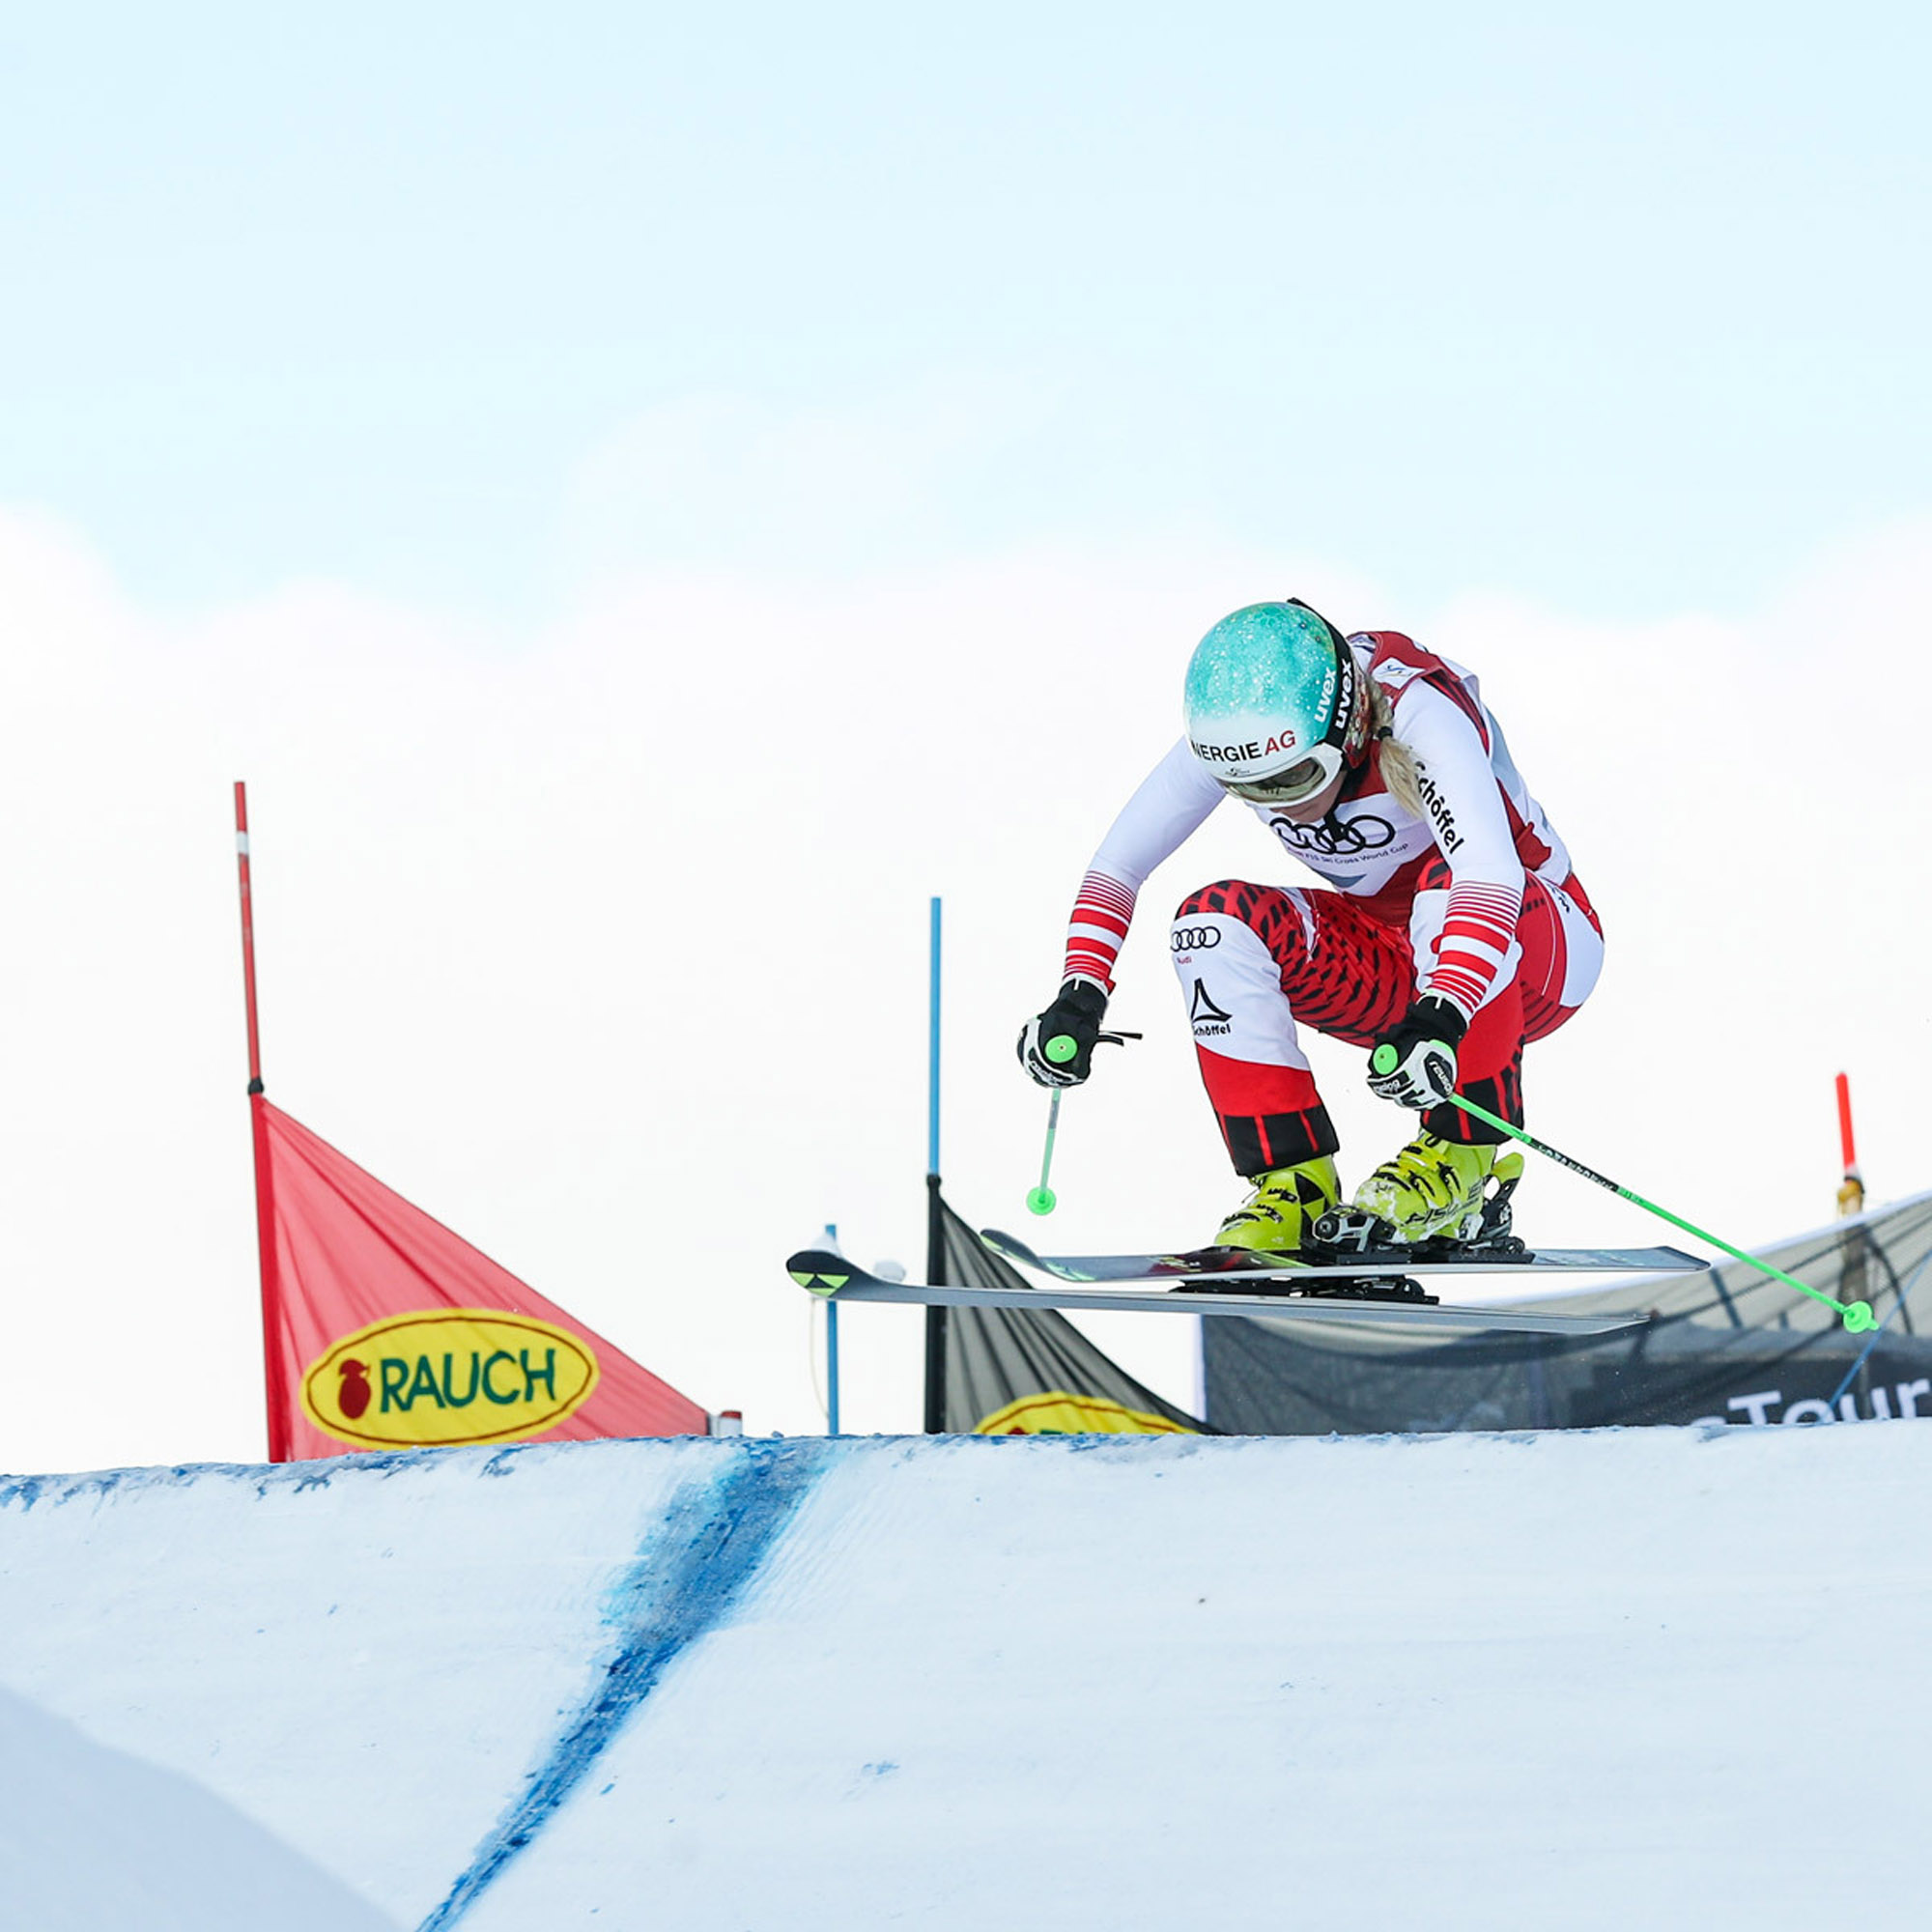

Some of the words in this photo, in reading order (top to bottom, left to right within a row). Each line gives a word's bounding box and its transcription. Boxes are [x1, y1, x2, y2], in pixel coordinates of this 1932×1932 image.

[1314, 667, 1337, 724] uvex
[1335, 658, 1352, 729] uvex
[1264, 729, 1296, 756] AG
[1335, 856, 1359, 865] Cross
[1359, 850, 1389, 863] World
[1389, 842, 1409, 854] Cup
[1192, 1023, 1232, 1037] chöffel
[380, 1348, 556, 1413] RAUCH
[1690, 1378, 1931, 1427] Tour
